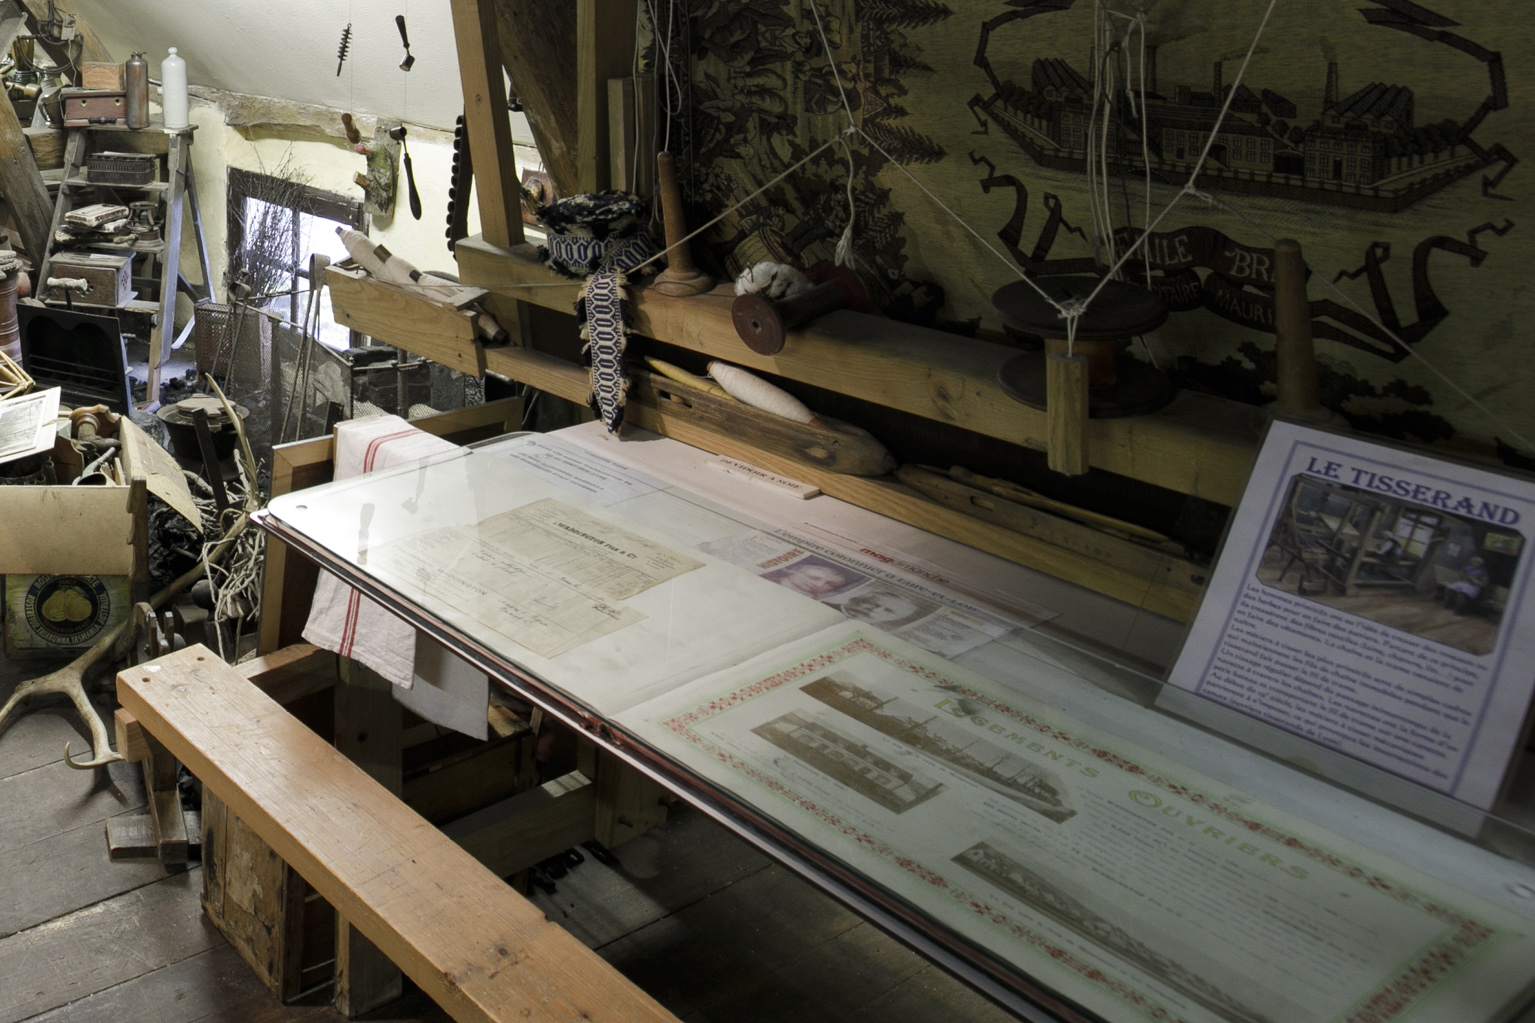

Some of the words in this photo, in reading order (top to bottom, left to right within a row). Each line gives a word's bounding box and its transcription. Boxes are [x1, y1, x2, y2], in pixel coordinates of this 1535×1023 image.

[1305, 456, 1342, 479] LE
[1350, 467, 1520, 526] TISSERAND
[1128, 789, 1309, 880] OUVRIERS
